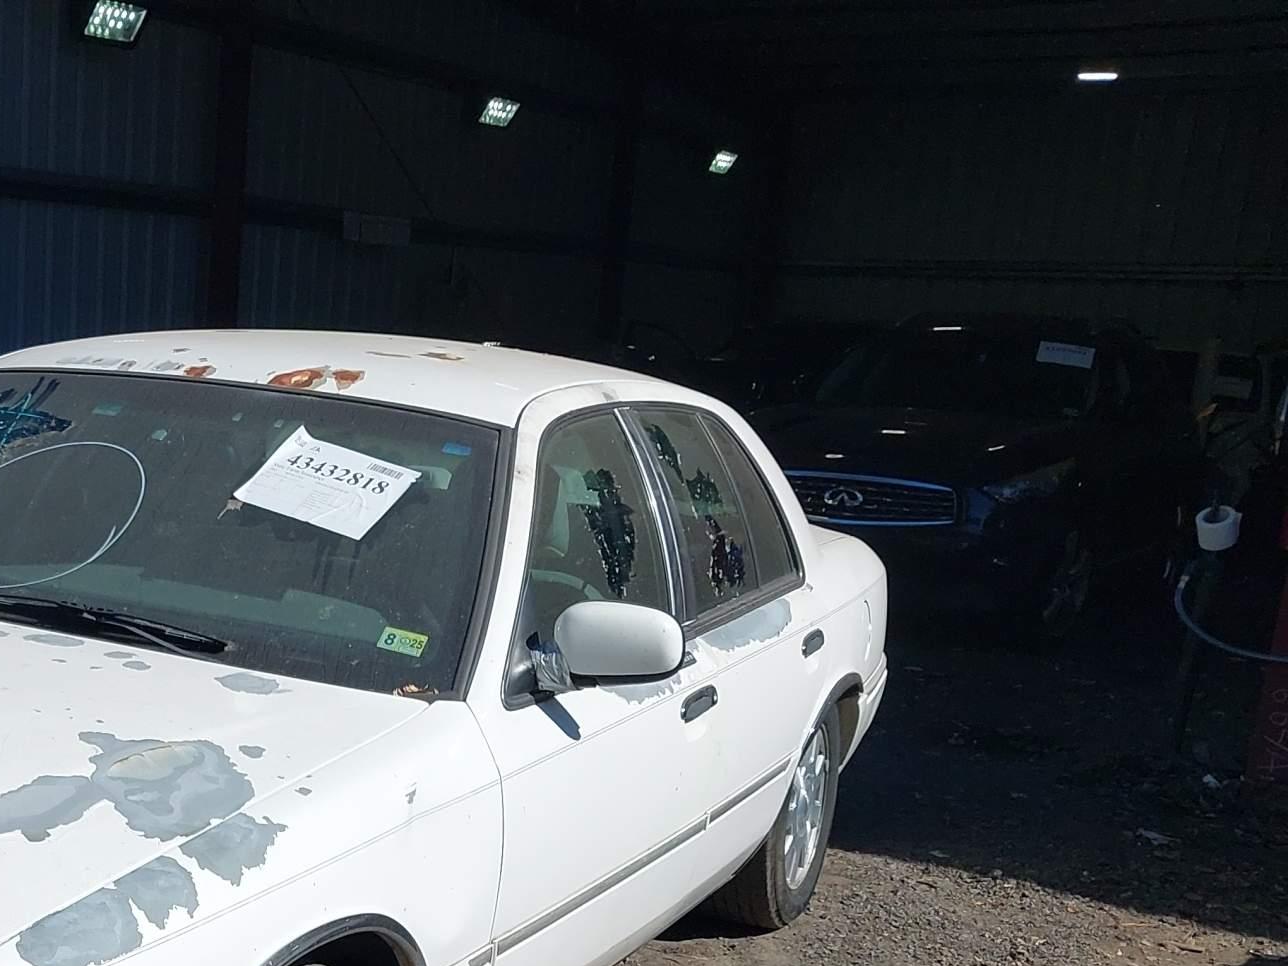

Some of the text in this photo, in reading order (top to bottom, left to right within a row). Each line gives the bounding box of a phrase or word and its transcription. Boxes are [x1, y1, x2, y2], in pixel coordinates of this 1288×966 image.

[287, 454, 390, 495] 43432818
[384, 633, 425, 650] 8 25
